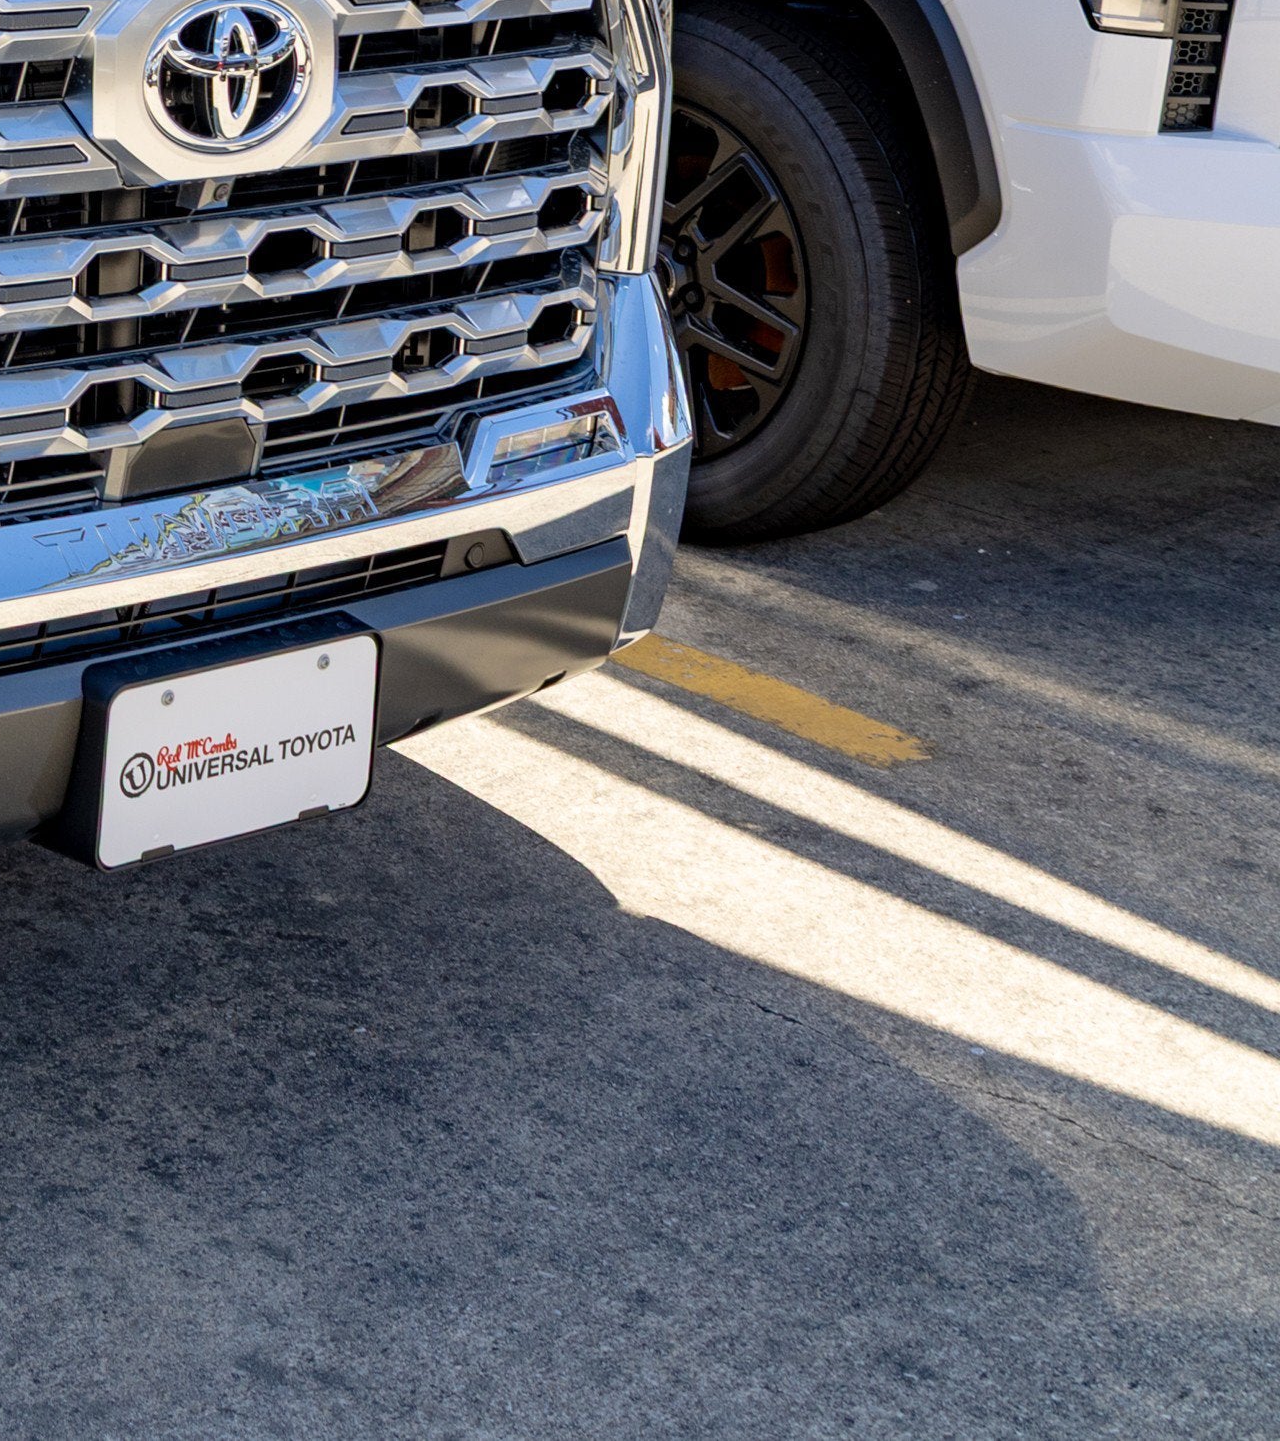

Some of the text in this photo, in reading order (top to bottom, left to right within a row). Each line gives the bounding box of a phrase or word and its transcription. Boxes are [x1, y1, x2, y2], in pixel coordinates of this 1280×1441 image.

[32, 477, 379, 577] TUNDRA
[156, 724, 356, 790] UNIVERSAL TOYOTA
[157, 733, 238, 772] Red McCombs
